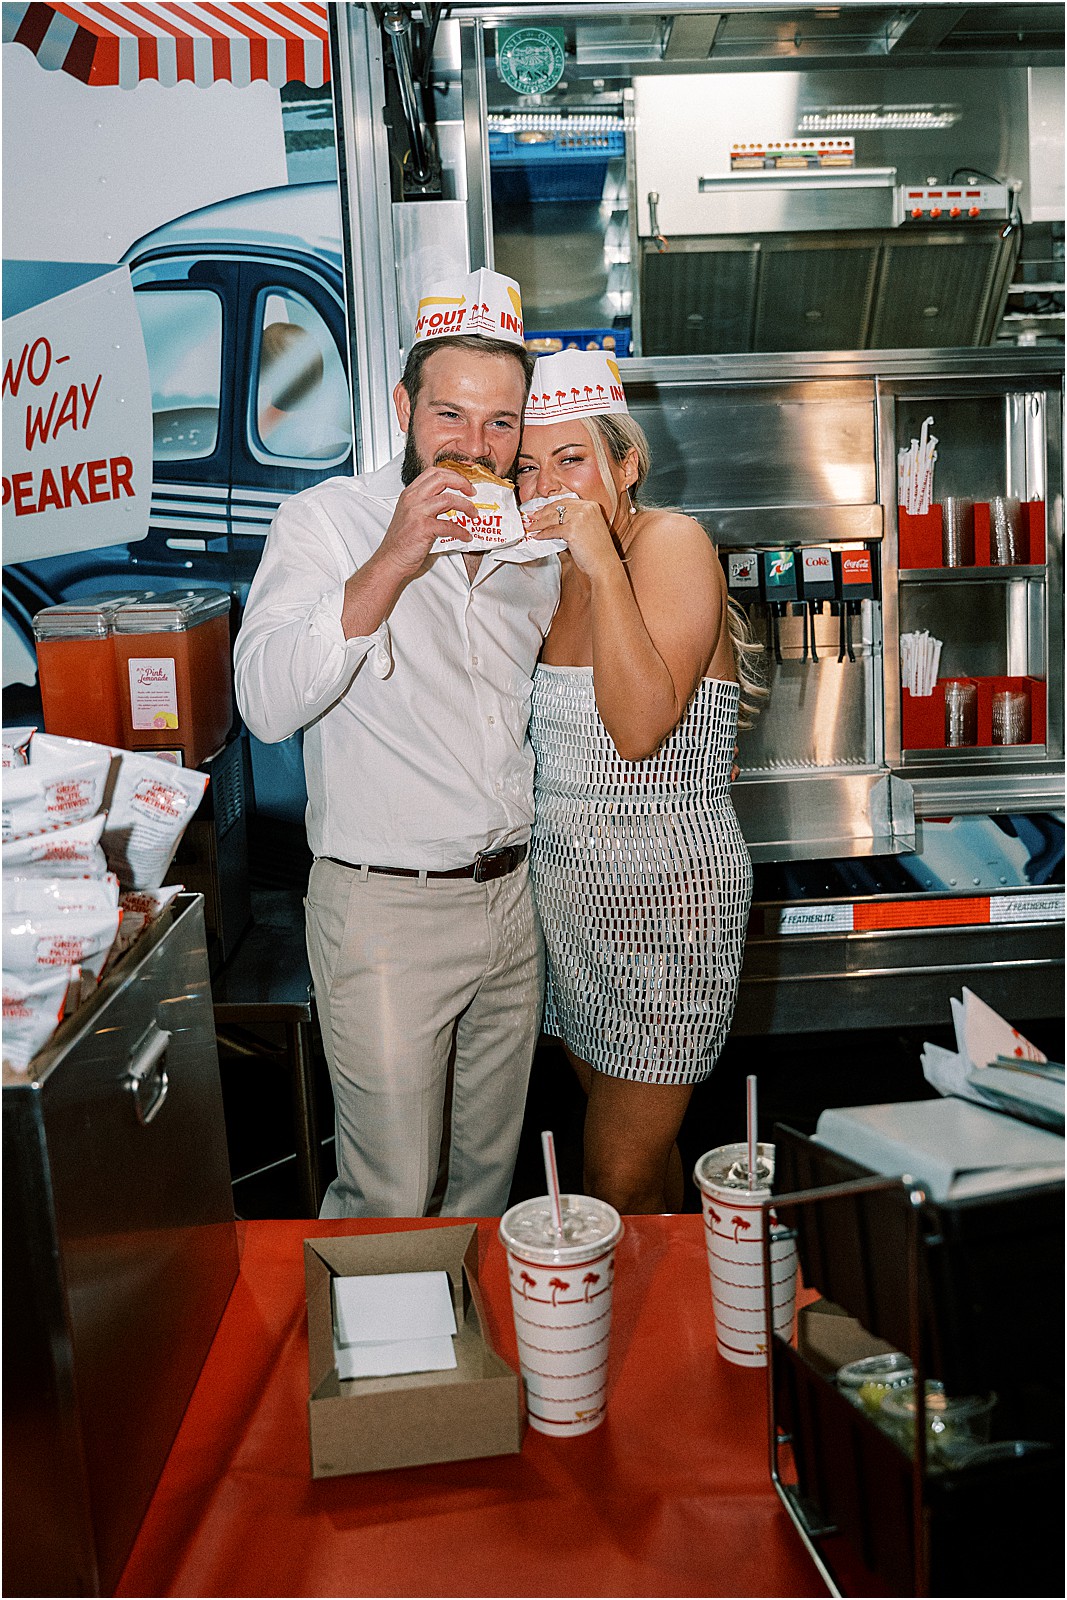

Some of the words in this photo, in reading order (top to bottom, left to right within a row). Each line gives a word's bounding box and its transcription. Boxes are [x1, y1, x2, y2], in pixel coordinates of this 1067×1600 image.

[426, 324, 462, 337] BURGER
[25, 374, 103, 452] WAY
[471, 526, 502, 535] BURGER
[805, 556, 829, 567] Coke
[144, 667, 163, 677] Pink
[137, 673, 169, 686] Lemonade
[788, 913, 835, 923] FEATHERLITE
